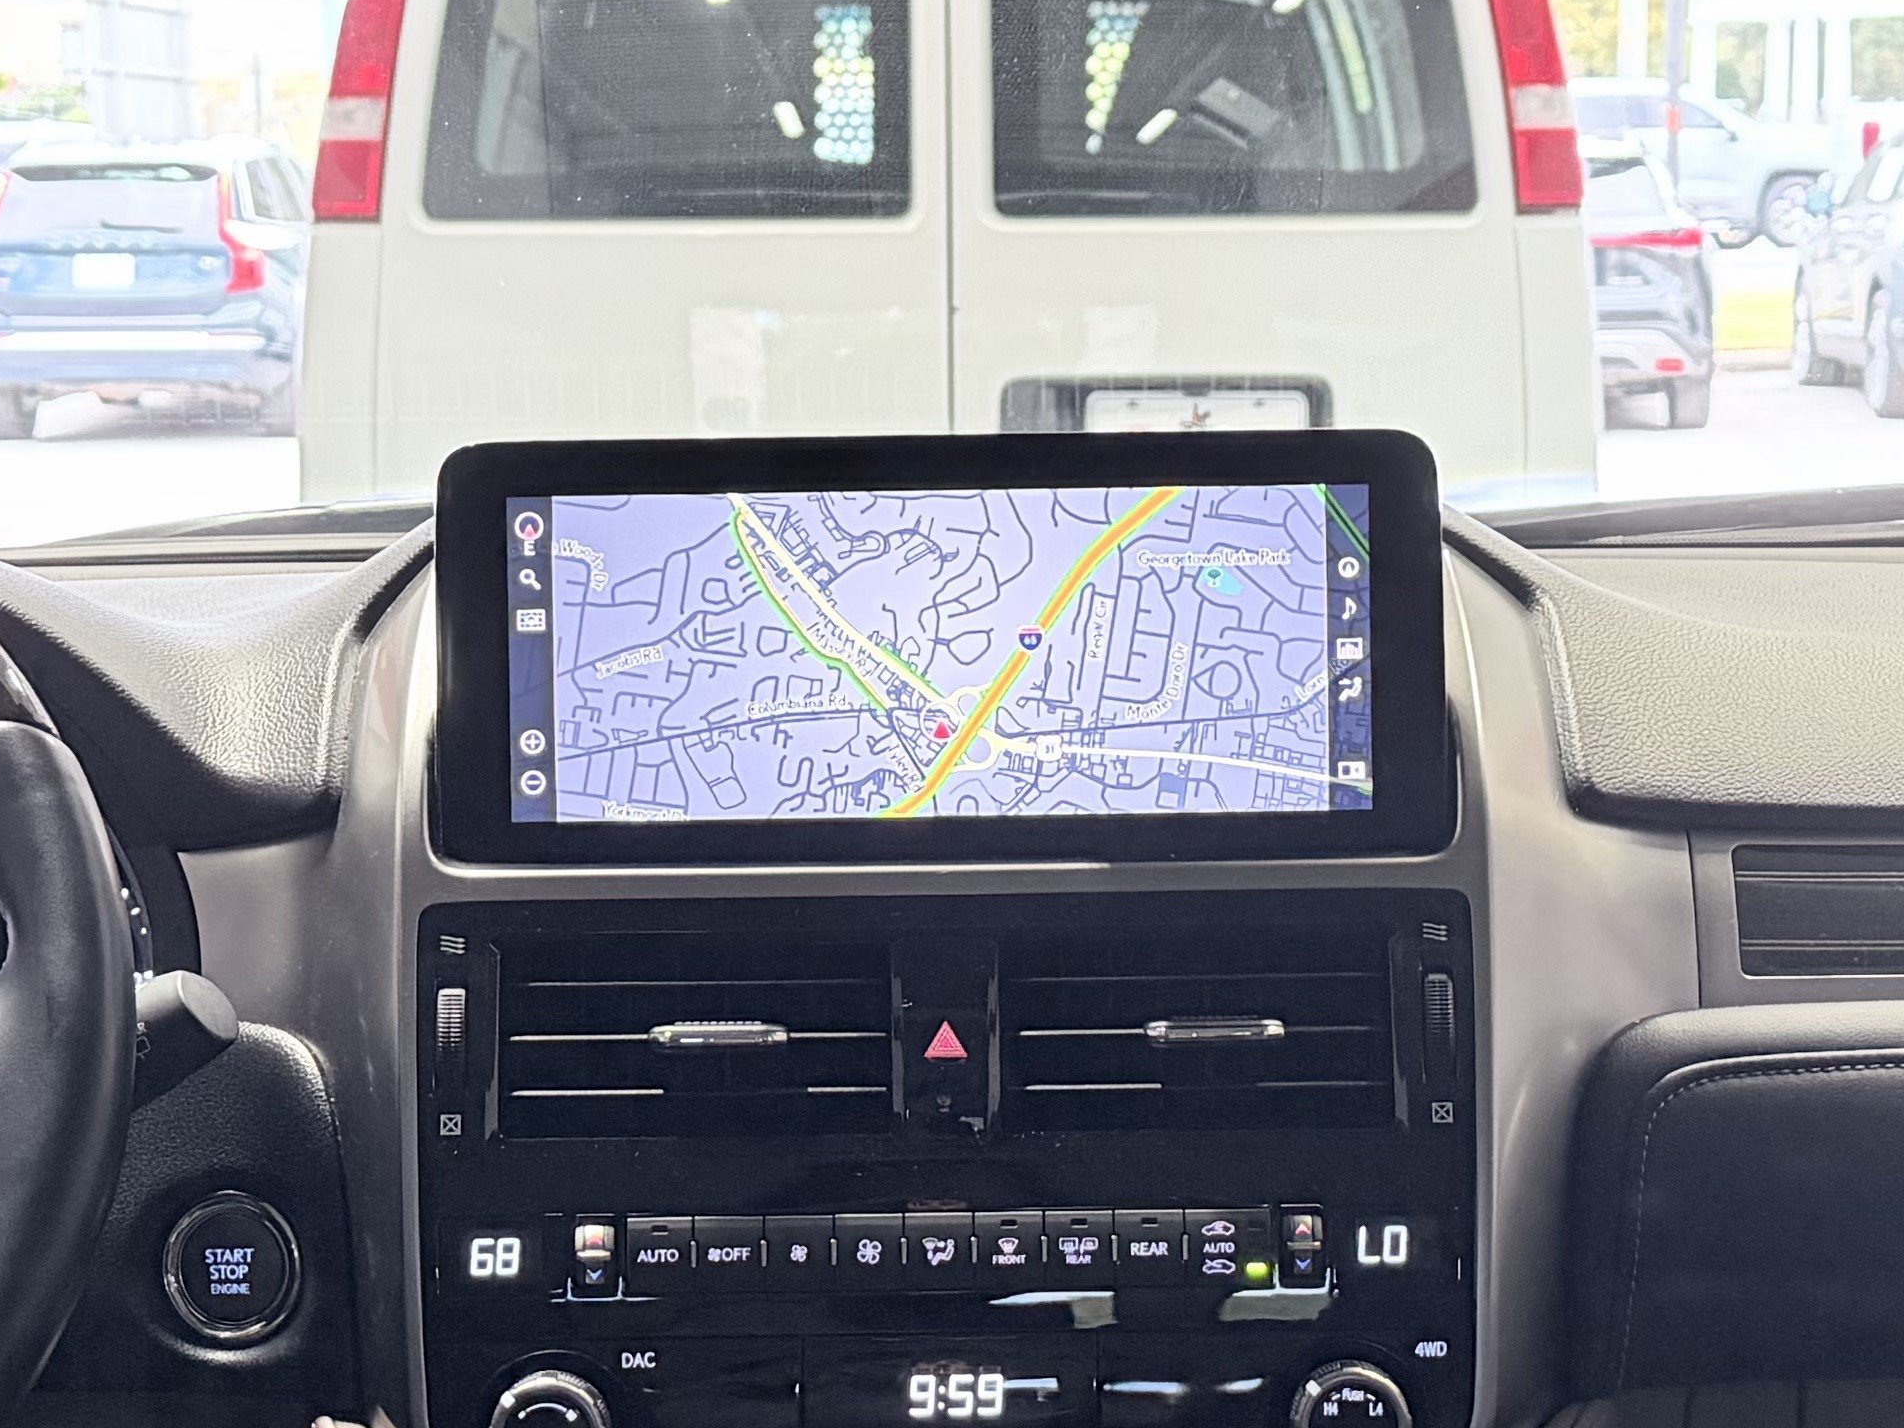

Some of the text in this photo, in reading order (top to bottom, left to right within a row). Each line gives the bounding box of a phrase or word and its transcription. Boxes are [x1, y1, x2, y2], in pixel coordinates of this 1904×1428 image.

[721, 1246, 752, 1262] OFF
[1130, 1242, 1169, 1257] REAR
[1203, 1241, 1235, 1254] AUTO
[205, 1248, 255, 1264] START
[469, 1237, 521, 1277] 68
[637, 1248, 679, 1264] AUTO
[992, 1253, 1027, 1265] FRONT
[1065, 1253, 1092, 1265] REAR
[209, 1264, 250, 1281] STOP
[210, 1283, 251, 1296] ENGINE
[1415, 1342, 1448, 1358] 4WD
[621, 1352, 657, 1369] DAC
[908, 1373, 1004, 1419] 9:59
[1323, 1402, 1339, 1416] H4
[1369, 1402, 1384, 1416] L4
